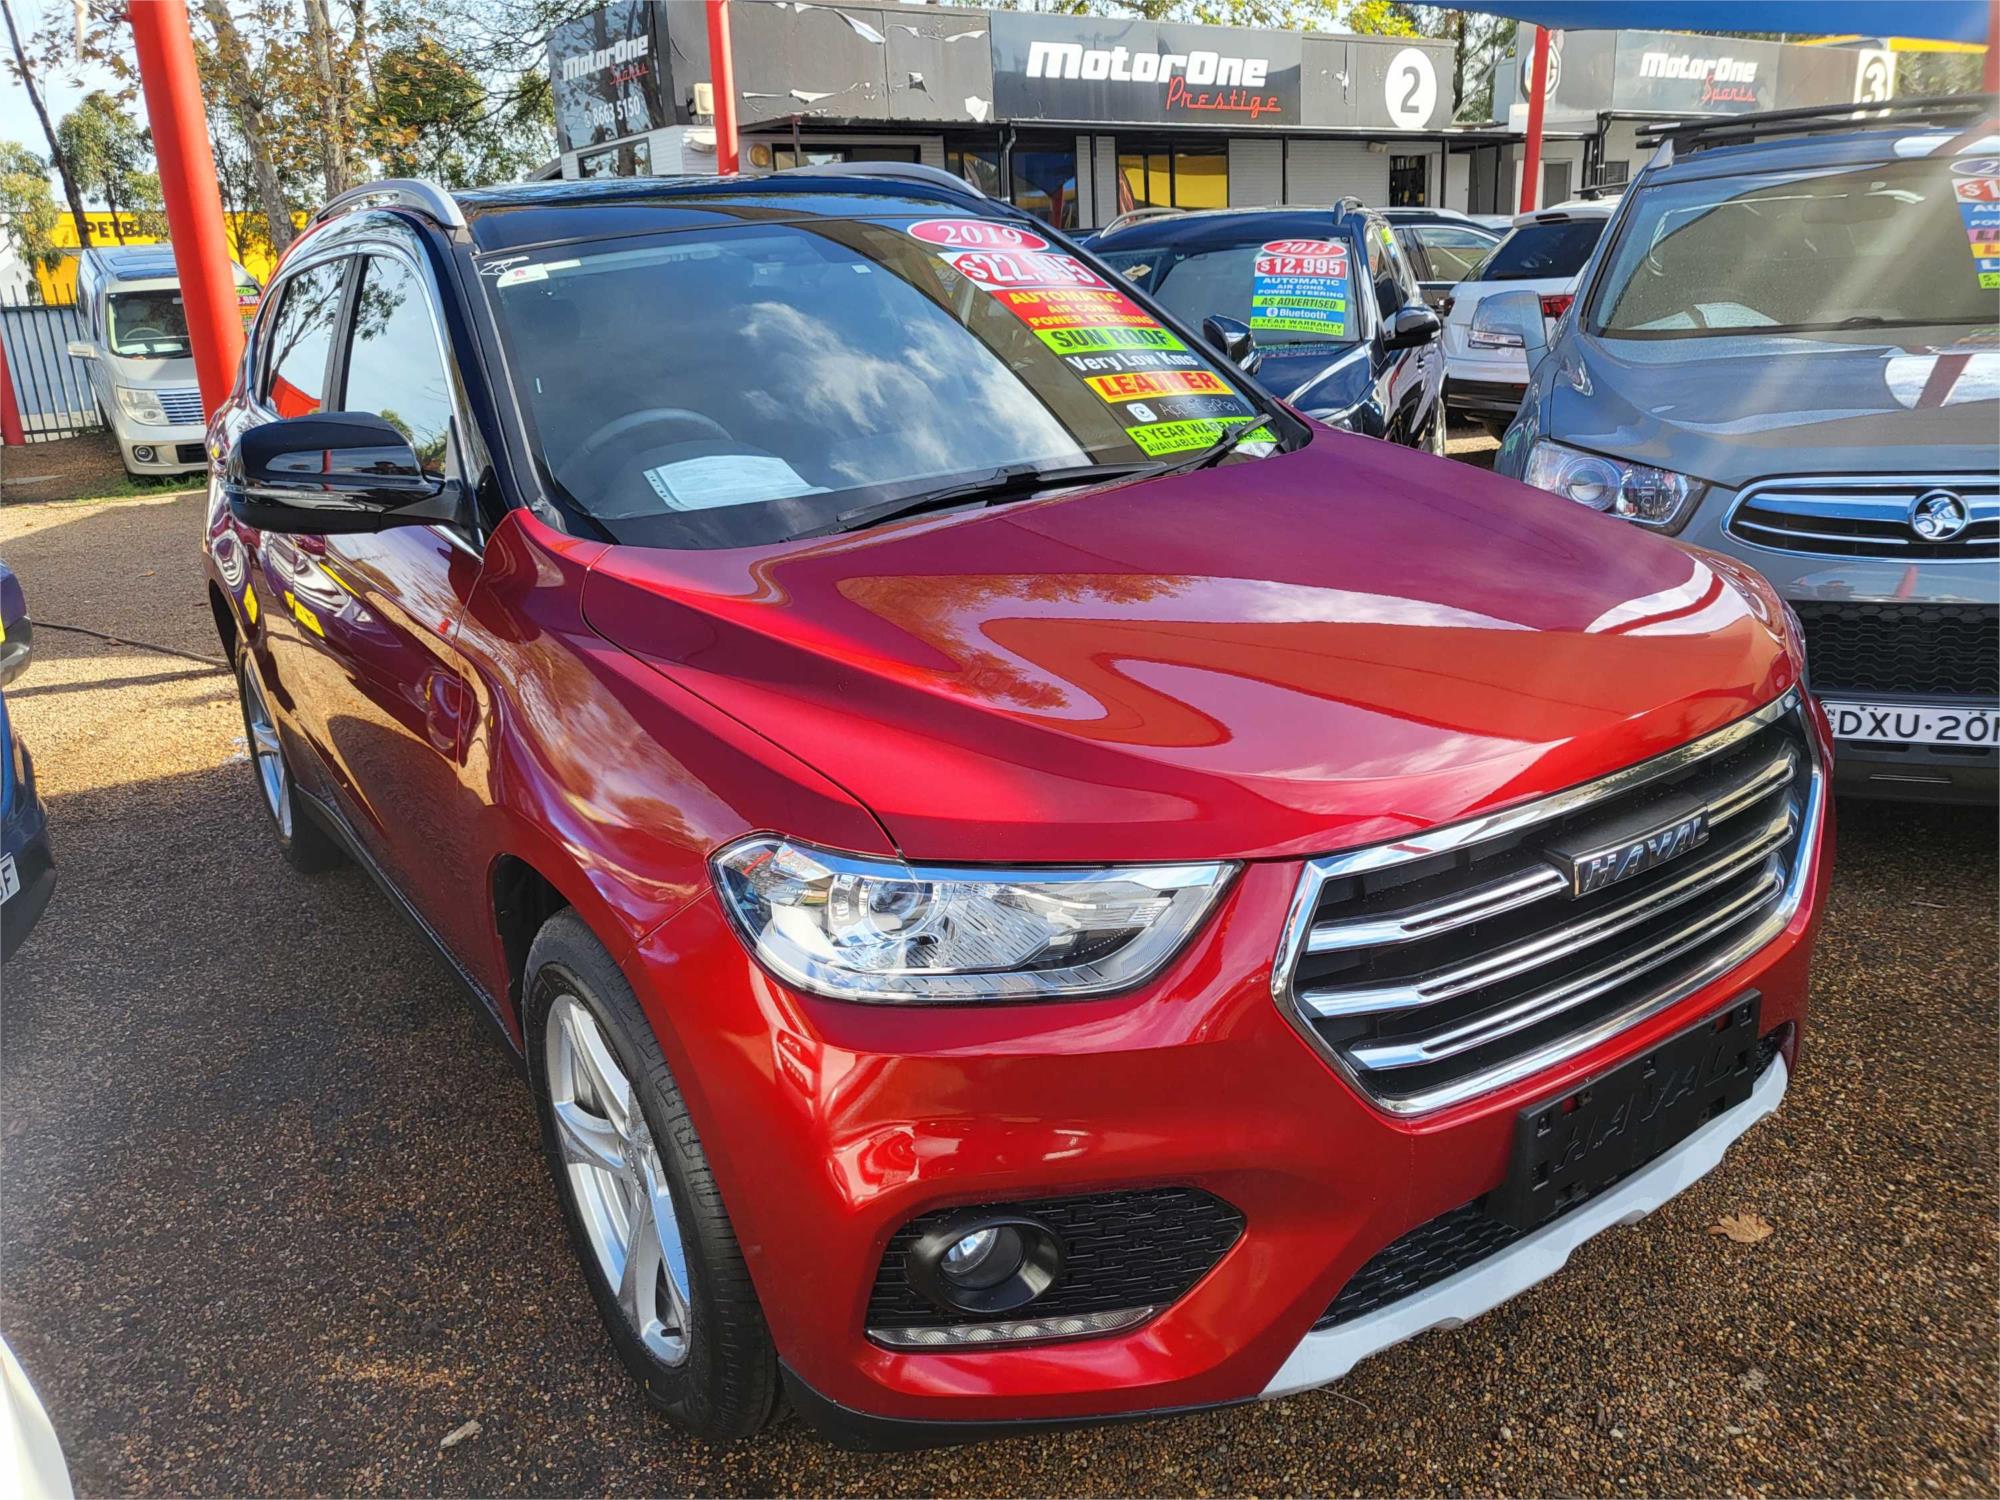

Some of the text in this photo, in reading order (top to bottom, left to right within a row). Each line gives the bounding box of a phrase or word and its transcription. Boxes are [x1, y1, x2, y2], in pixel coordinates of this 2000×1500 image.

[563, 35, 649, 81] MotorOne
[1026, 41, 1269, 87] MotorOne
[1639, 52, 1759, 83] MotorOne
[1401, 66, 1421, 113] 2
[1701, 74, 1756, 106] Sports
[1862, 62, 1886, 103] 3
[1166, 76, 1282, 119] Prestige
[592, 95, 641, 127] 8663 5150
[937, 224, 1023, 246] 2019
[1276, 242, 1332, 254] 2013
[959, 251, 1096, 284] $22,995
[1260, 258, 1341, 275] $12,995
[1262, 277, 1340, 286] AUTOMATIC
[1008, 290, 1123, 305] AUTOMATIC
[1261, 298, 1337, 310] AS ADVERTISED
[1295, 290, 1344, 298] STEERING
[1047, 304, 1074, 314] AIR
[1279, 308, 1327, 320] Bluetooth
[1028, 314, 1155, 327] POWER STEERING
[1050, 328, 1169, 348] SUN ROOF
[1066, 351, 1199, 371] Very Low Kms
[1097, 371, 1222, 396] LEATHER
[1133, 430, 1148, 443] 5
[1146, 425, 1190, 440] YEAR
[1146, 437, 1198, 452] AVAILABLE
